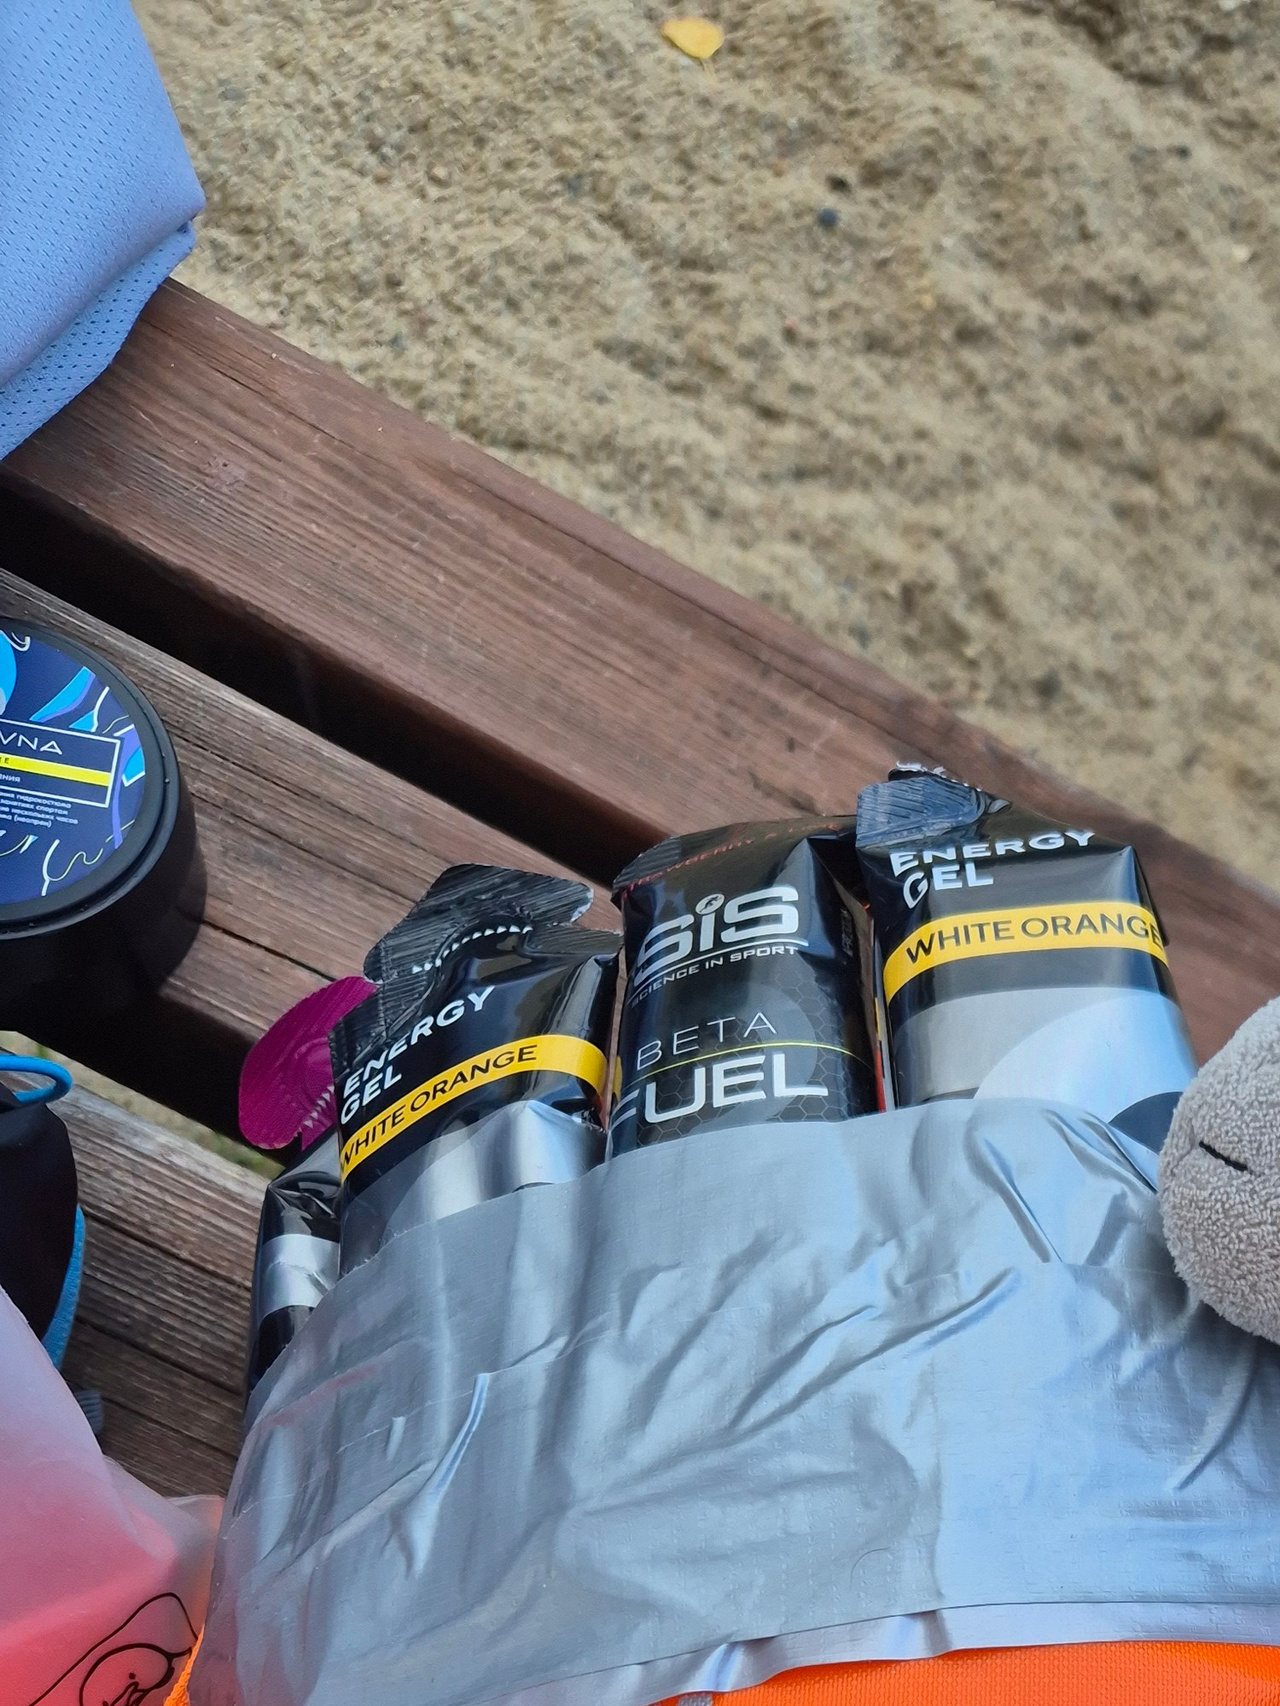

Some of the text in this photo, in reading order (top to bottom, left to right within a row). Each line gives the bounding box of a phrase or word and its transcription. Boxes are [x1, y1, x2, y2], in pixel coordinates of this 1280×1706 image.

[889, 829, 1096, 878] ENERGY
[902, 862, 994, 909] GEL
[705, 955, 724, 970] IN
[730, 946, 799, 963] SPORT
[905, 919, 1015, 965] WHITE
[1020, 912, 1165, 949] ORANGE
[343, 986, 496, 1099] ENERGY
[636, 1012, 777, 1071] BETA
[340, 1064, 403, 1126] GEL
[341, 1044, 538, 1173] WHITE ORANGE
